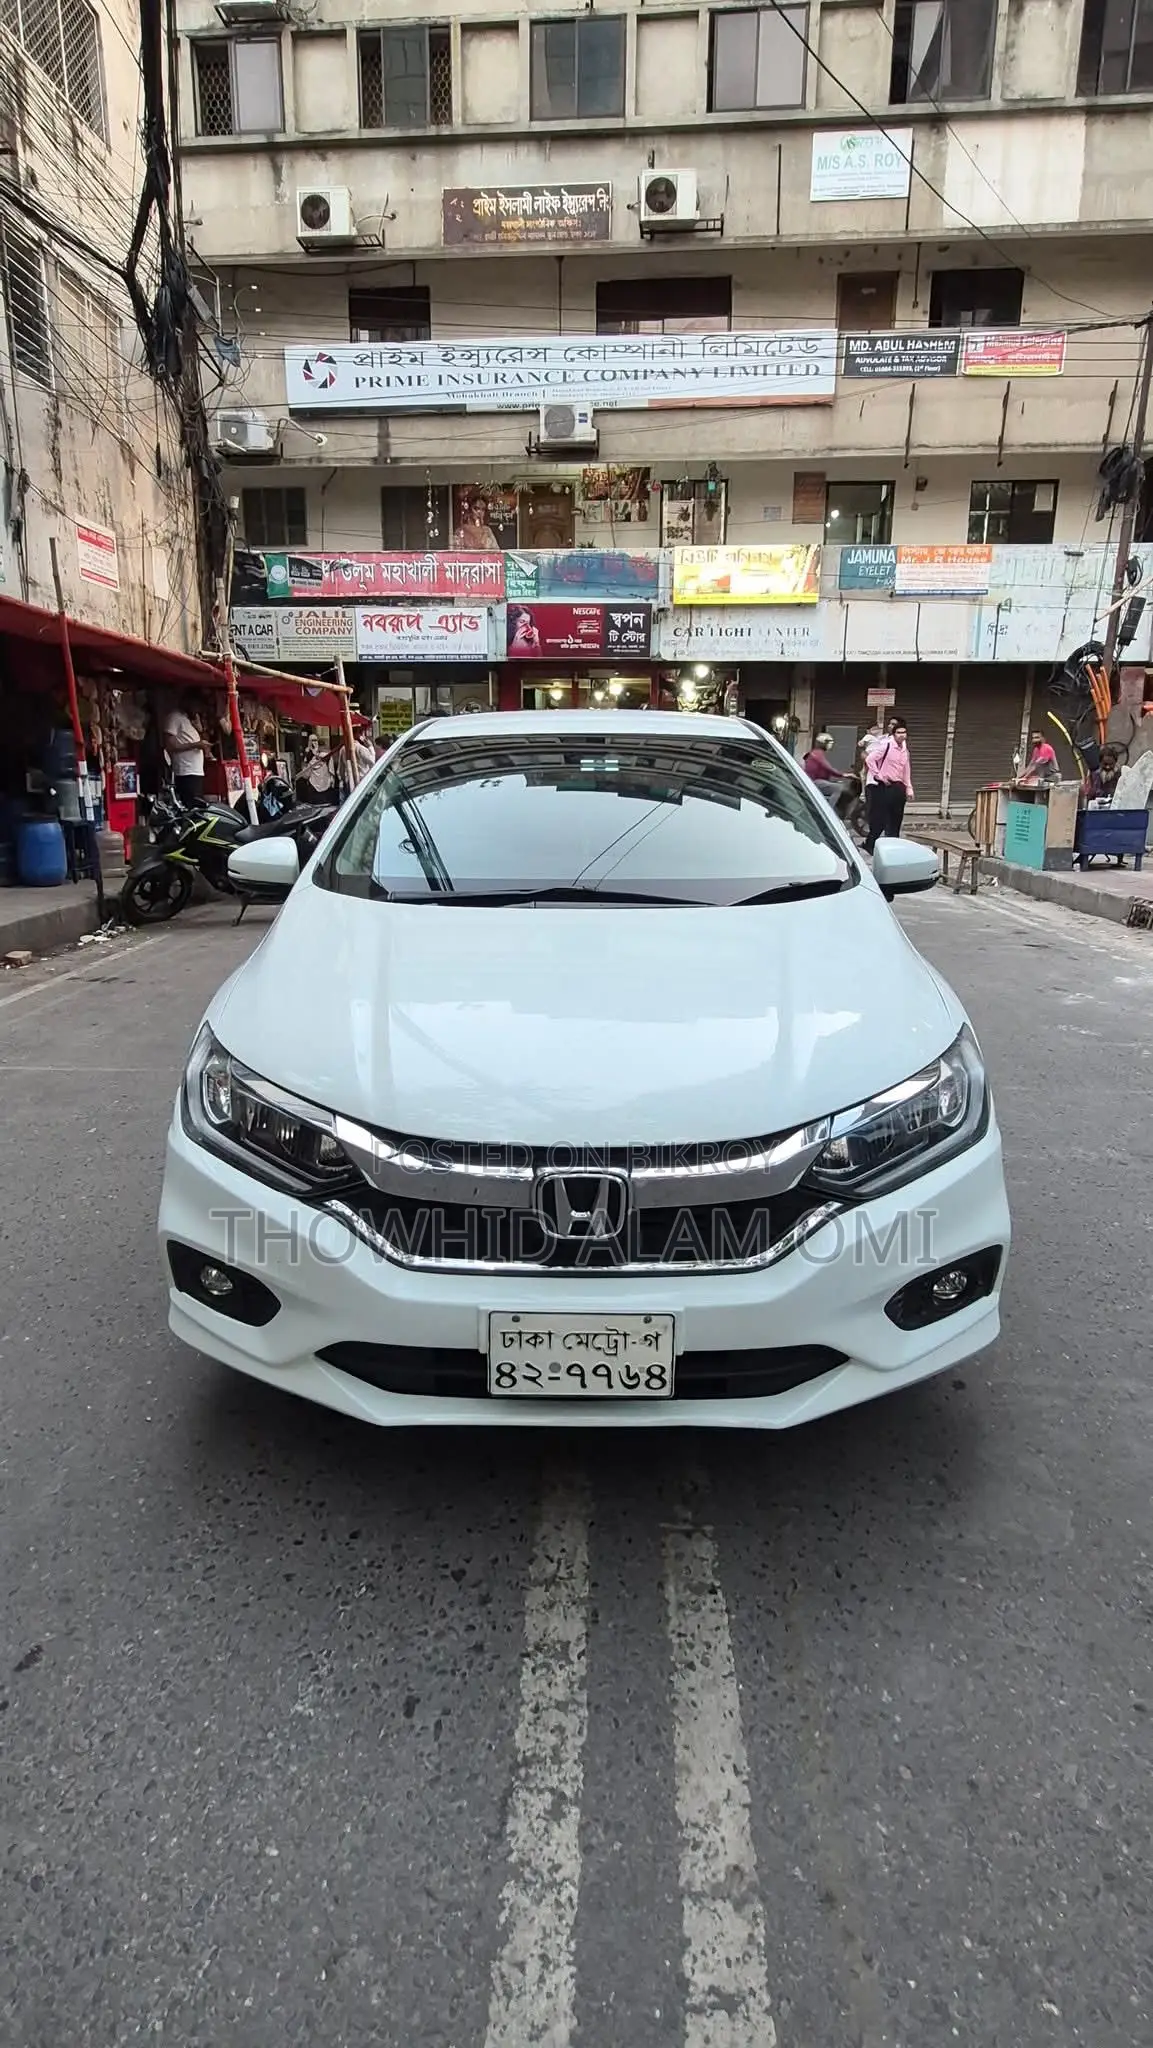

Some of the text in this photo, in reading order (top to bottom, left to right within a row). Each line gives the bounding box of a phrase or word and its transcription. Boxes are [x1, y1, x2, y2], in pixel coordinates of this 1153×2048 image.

[817, 154, 840, 171] M/S
[874, 152, 901, 168] ROY
[472, 192, 497, 217] প্রাইম
[497, 190, 532, 217] ইসলামী
[534, 189, 561, 215] লাইফ
[353, 347, 424, 368] প্রাইম
[564, 337, 688, 362] কোম্পানী
[698, 335, 821, 358] লিমিটেড
[849, 340, 872, 351] MD.
[875, 339, 905, 351] ABUL
[907, 339, 956, 351] HASHEM
[855, 355, 892, 363] ADVOCATE
[894, 355, 900, 363] &
[353, 363, 820, 389] PRIME INSURANCE COMPANY LIMITED
[848, 549, 896, 564] JAMUNA
[947, 556, 988, 564] House
[381, 554, 437, 585] মহাখালী
[858, 565, 892, 576] EYELET
[294, 611, 353, 619] JALIL
[609, 612, 646, 628] স্বপন
[295, 619, 353, 627] ENGINEERING
[361, 612, 423, 633] নবরূপ
[229, 624, 274, 636] ENT A CAR
[295, 627, 353, 636] COMPANY
[608, 630, 646, 643] টি স্টোর
[673, 627, 704, 637] CAR
[710, 627, 752, 637] LIGHT
[500, 1331, 554, 1350] ঢাকা
[495, 1362, 668, 1390] ৪২-৭৭৬৪
